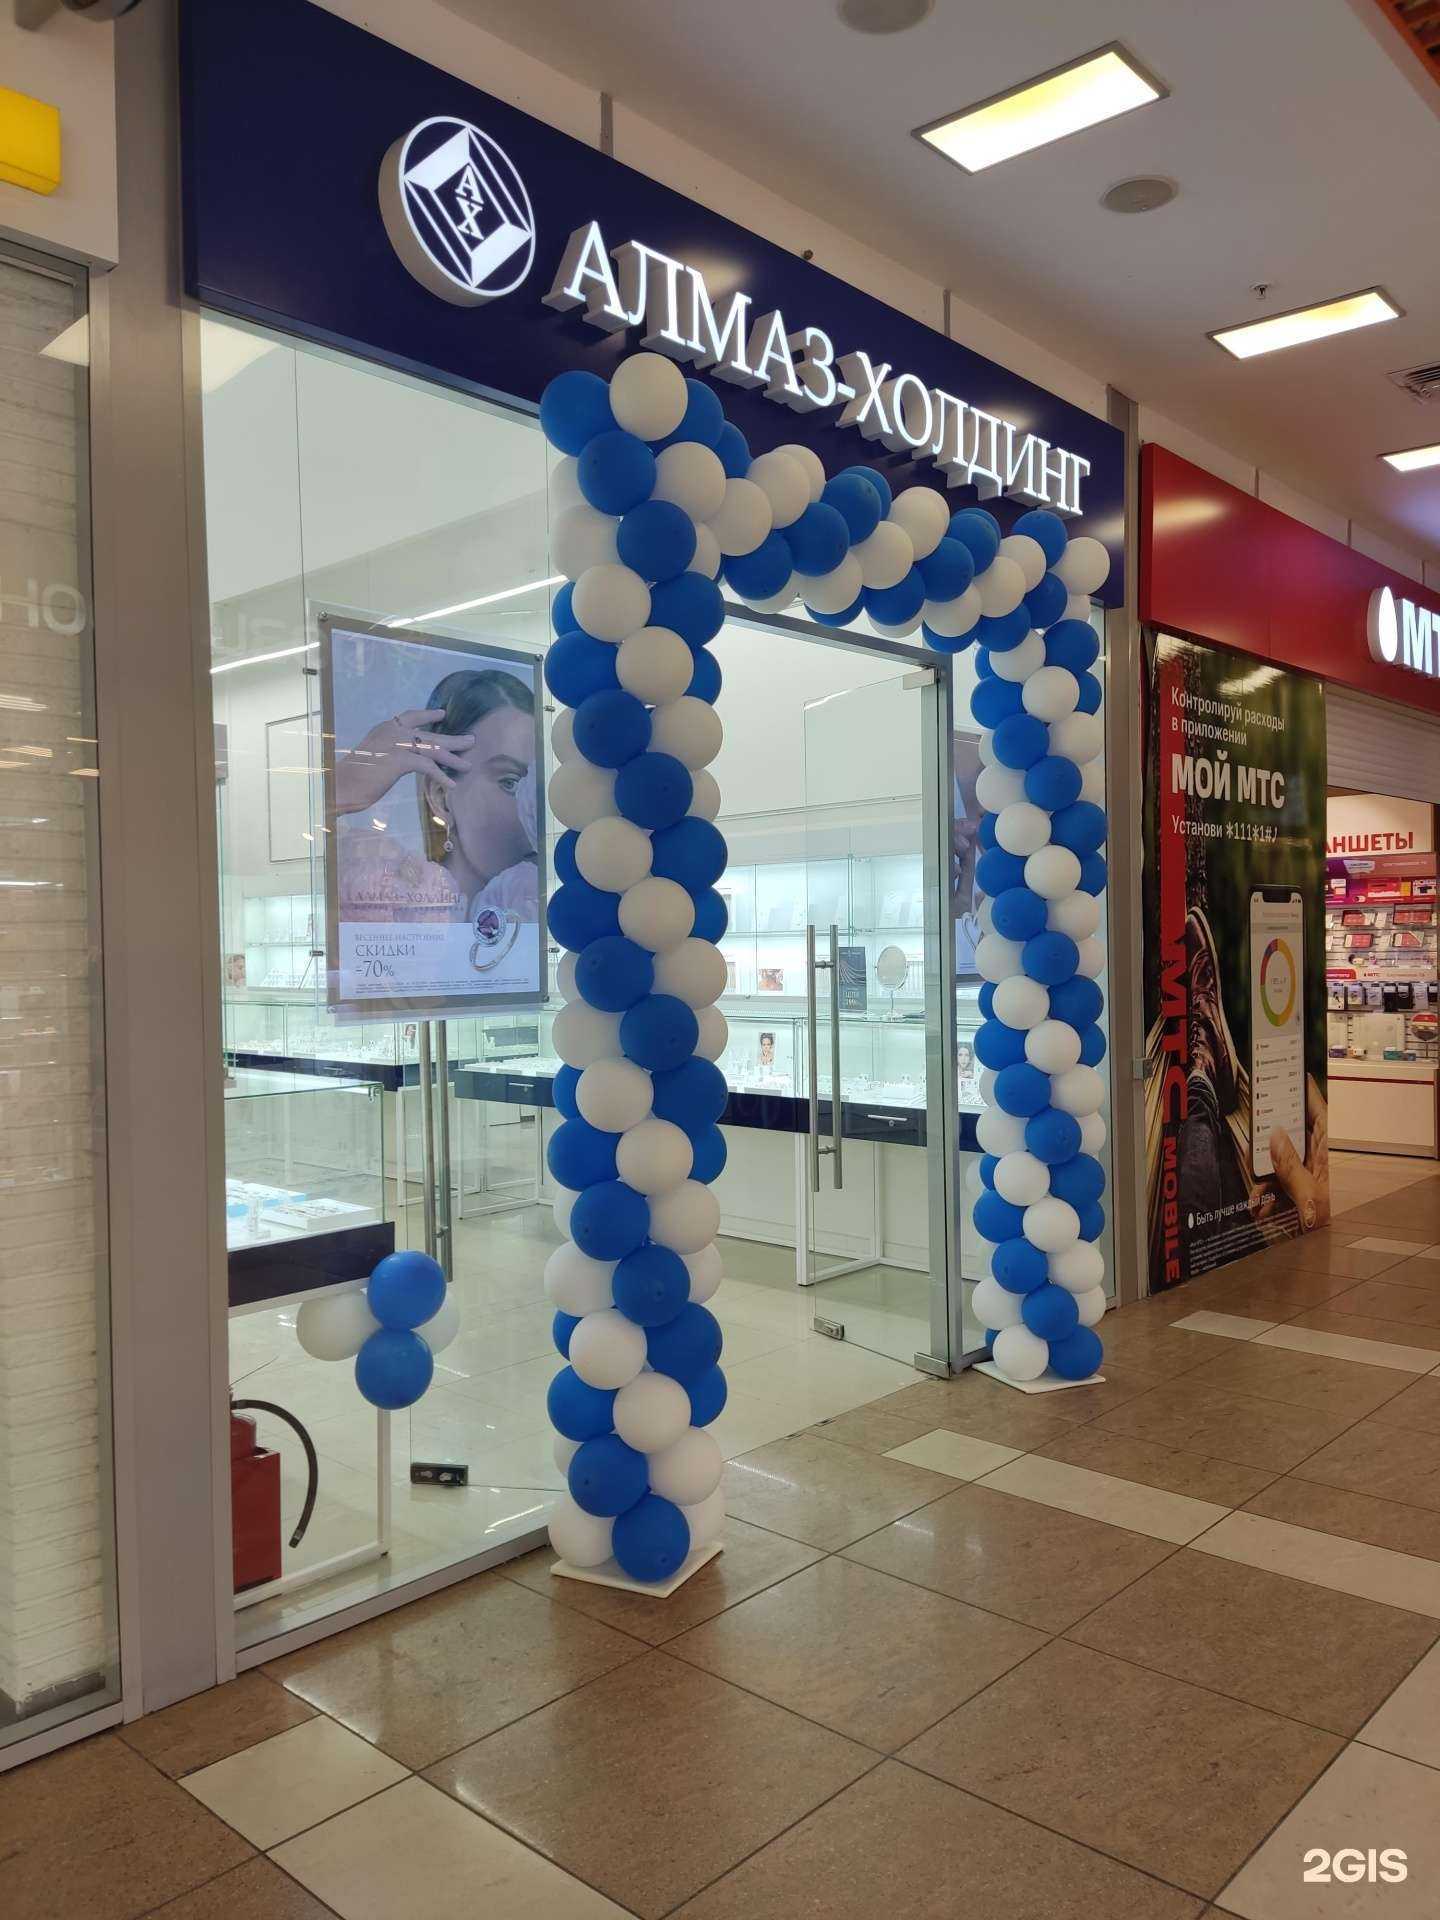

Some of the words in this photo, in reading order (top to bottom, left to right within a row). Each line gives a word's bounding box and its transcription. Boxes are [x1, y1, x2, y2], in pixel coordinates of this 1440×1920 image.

[563, 220, 1091, 516] АЛМАЗ-ХОЛДИНГ
[1171, 686, 1243, 724] Контролируй
[1244, 709, 1285, 732] расходы
[1171, 717, 1178, 731] в
[1181, 719, 1247, 746] приложении
[1172, 749, 1231, 801] МОЙ
[1237, 765, 1285, 809] МТС
[1171, 814, 1223, 839] Установи
[355, 944, 416, 957] СКИДКИ
[355, 960, 395, 978] -70%
[1163, 1136, 1180, 1283] MOBILE
[1196, 1212, 1214, 1226] Быть
[1214, 1204, 1235, 1222] лучше
